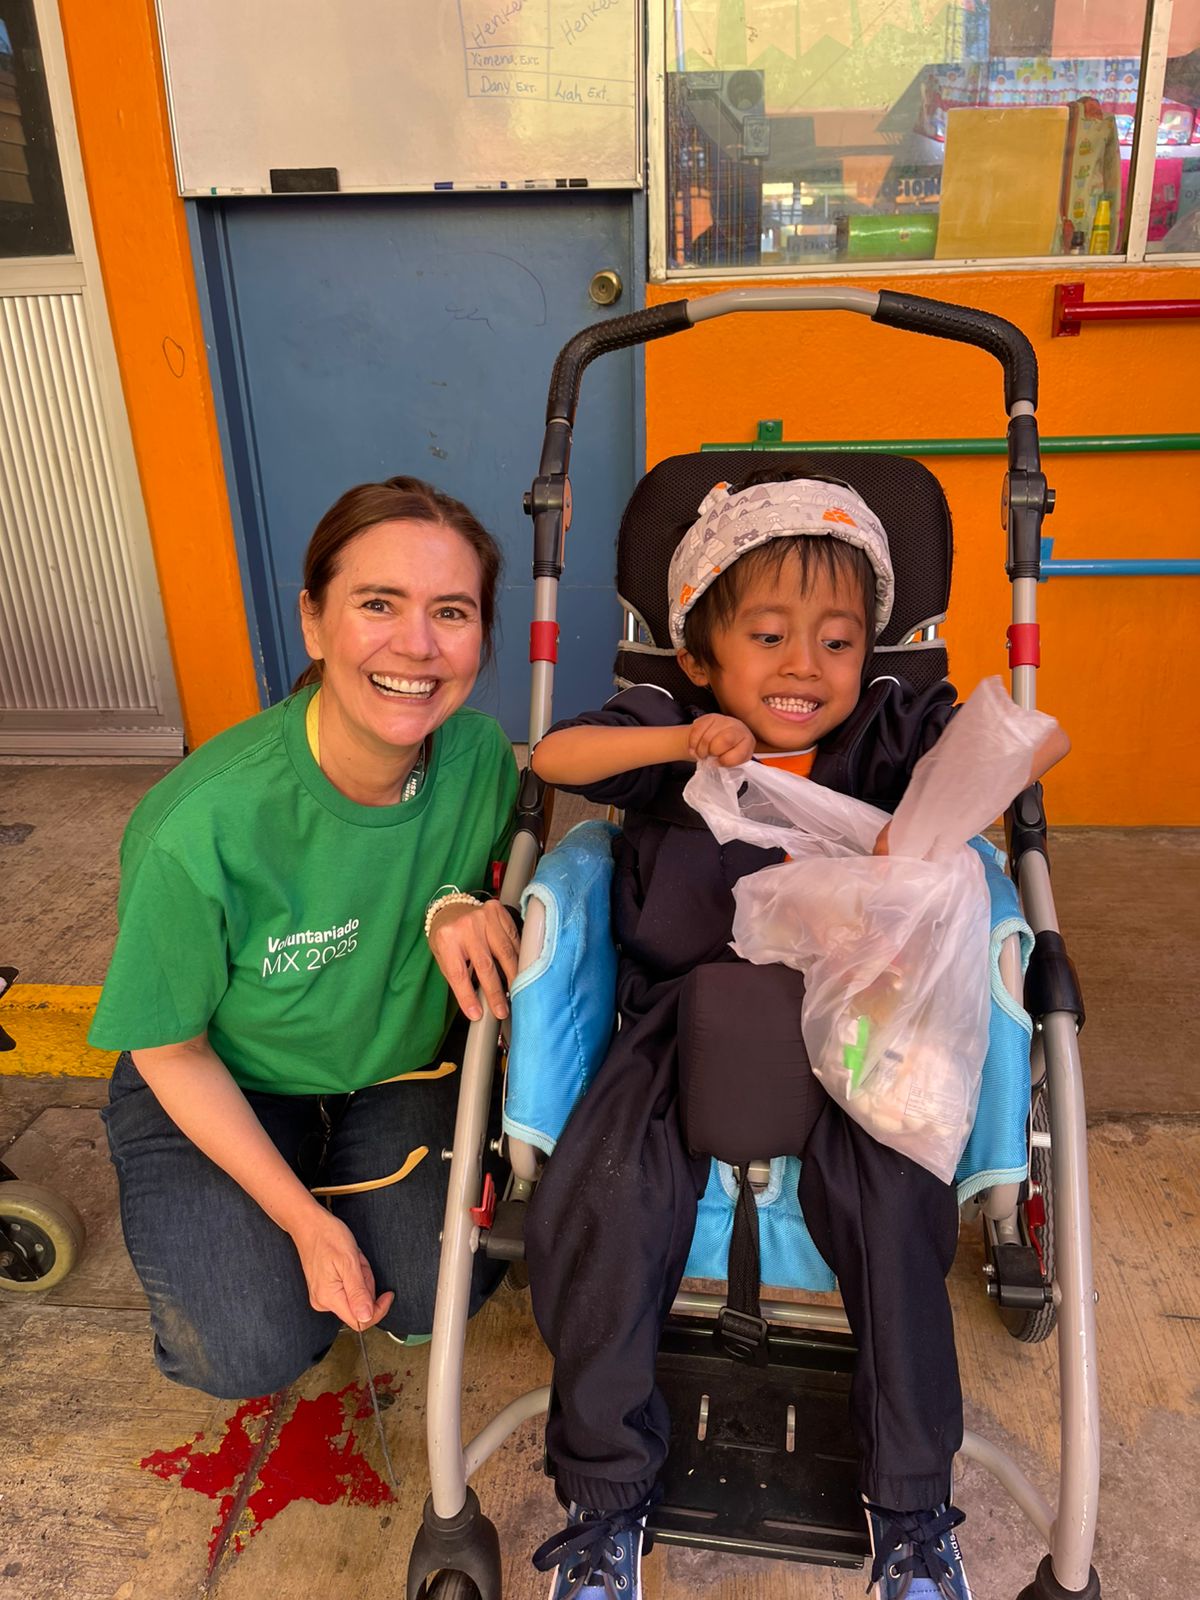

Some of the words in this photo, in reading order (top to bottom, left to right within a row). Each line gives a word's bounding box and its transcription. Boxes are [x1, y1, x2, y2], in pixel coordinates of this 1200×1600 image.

[471, 0, 527, 48] Henke
[480, 75, 511, 95] Dany
[262, 950, 300, 977] MX
[306, 932, 358, 970] 2025
[268, 919, 359, 953] Voluntariado
